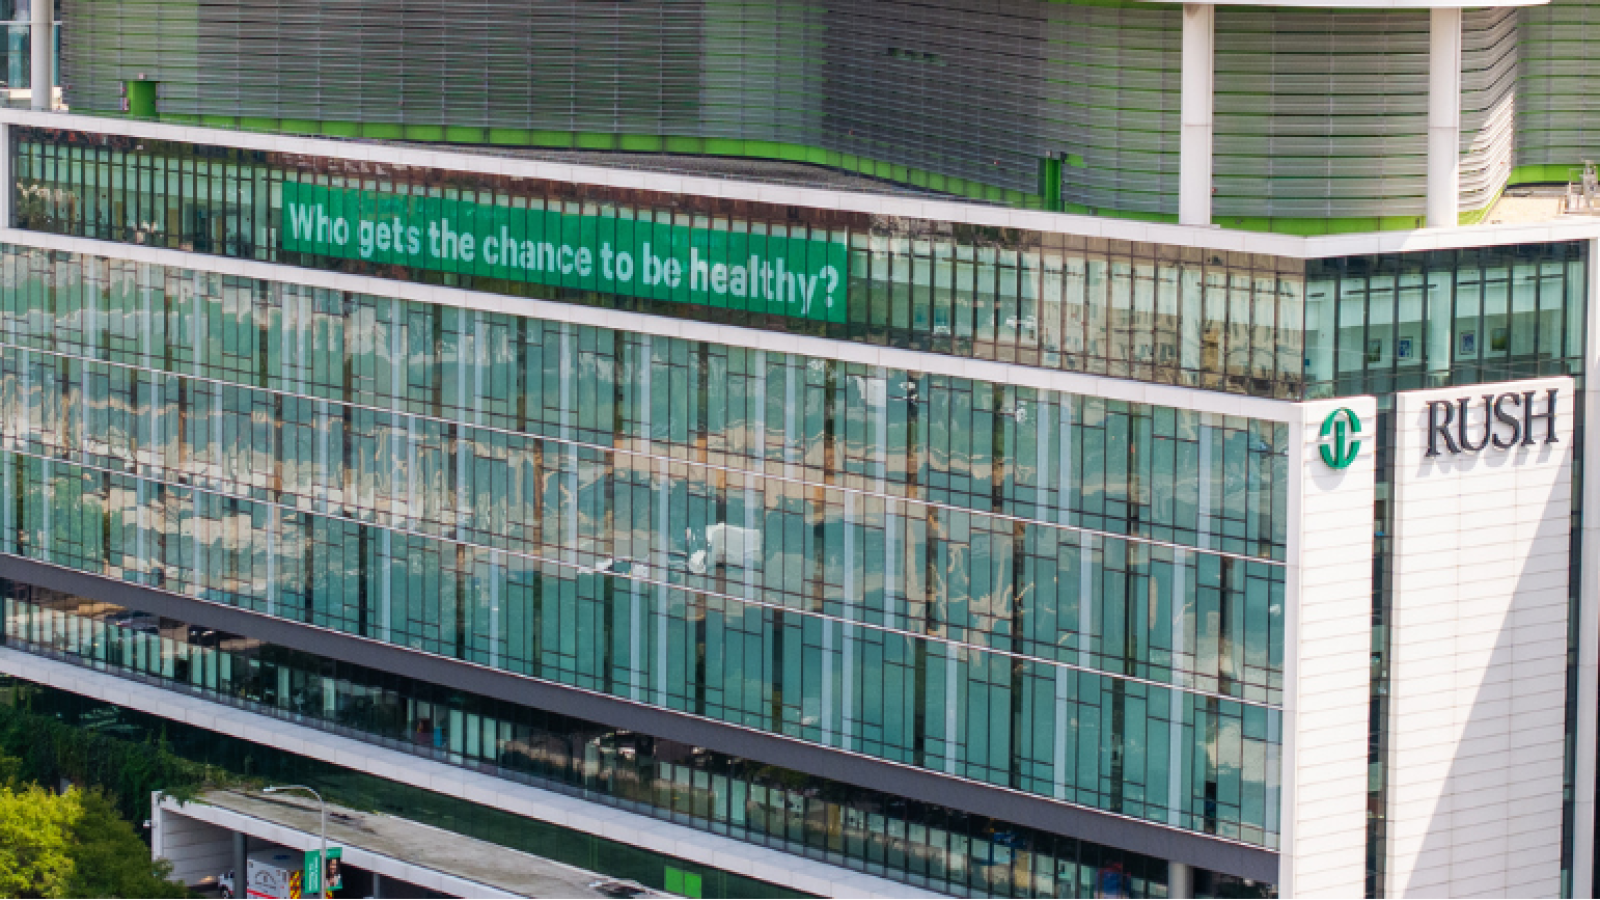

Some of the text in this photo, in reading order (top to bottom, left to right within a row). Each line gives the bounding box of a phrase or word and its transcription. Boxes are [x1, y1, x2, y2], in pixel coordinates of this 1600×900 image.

[289, 203, 839, 315] Who gets the chance to be healthy?
[1424, 388, 1559, 457] RUSH
